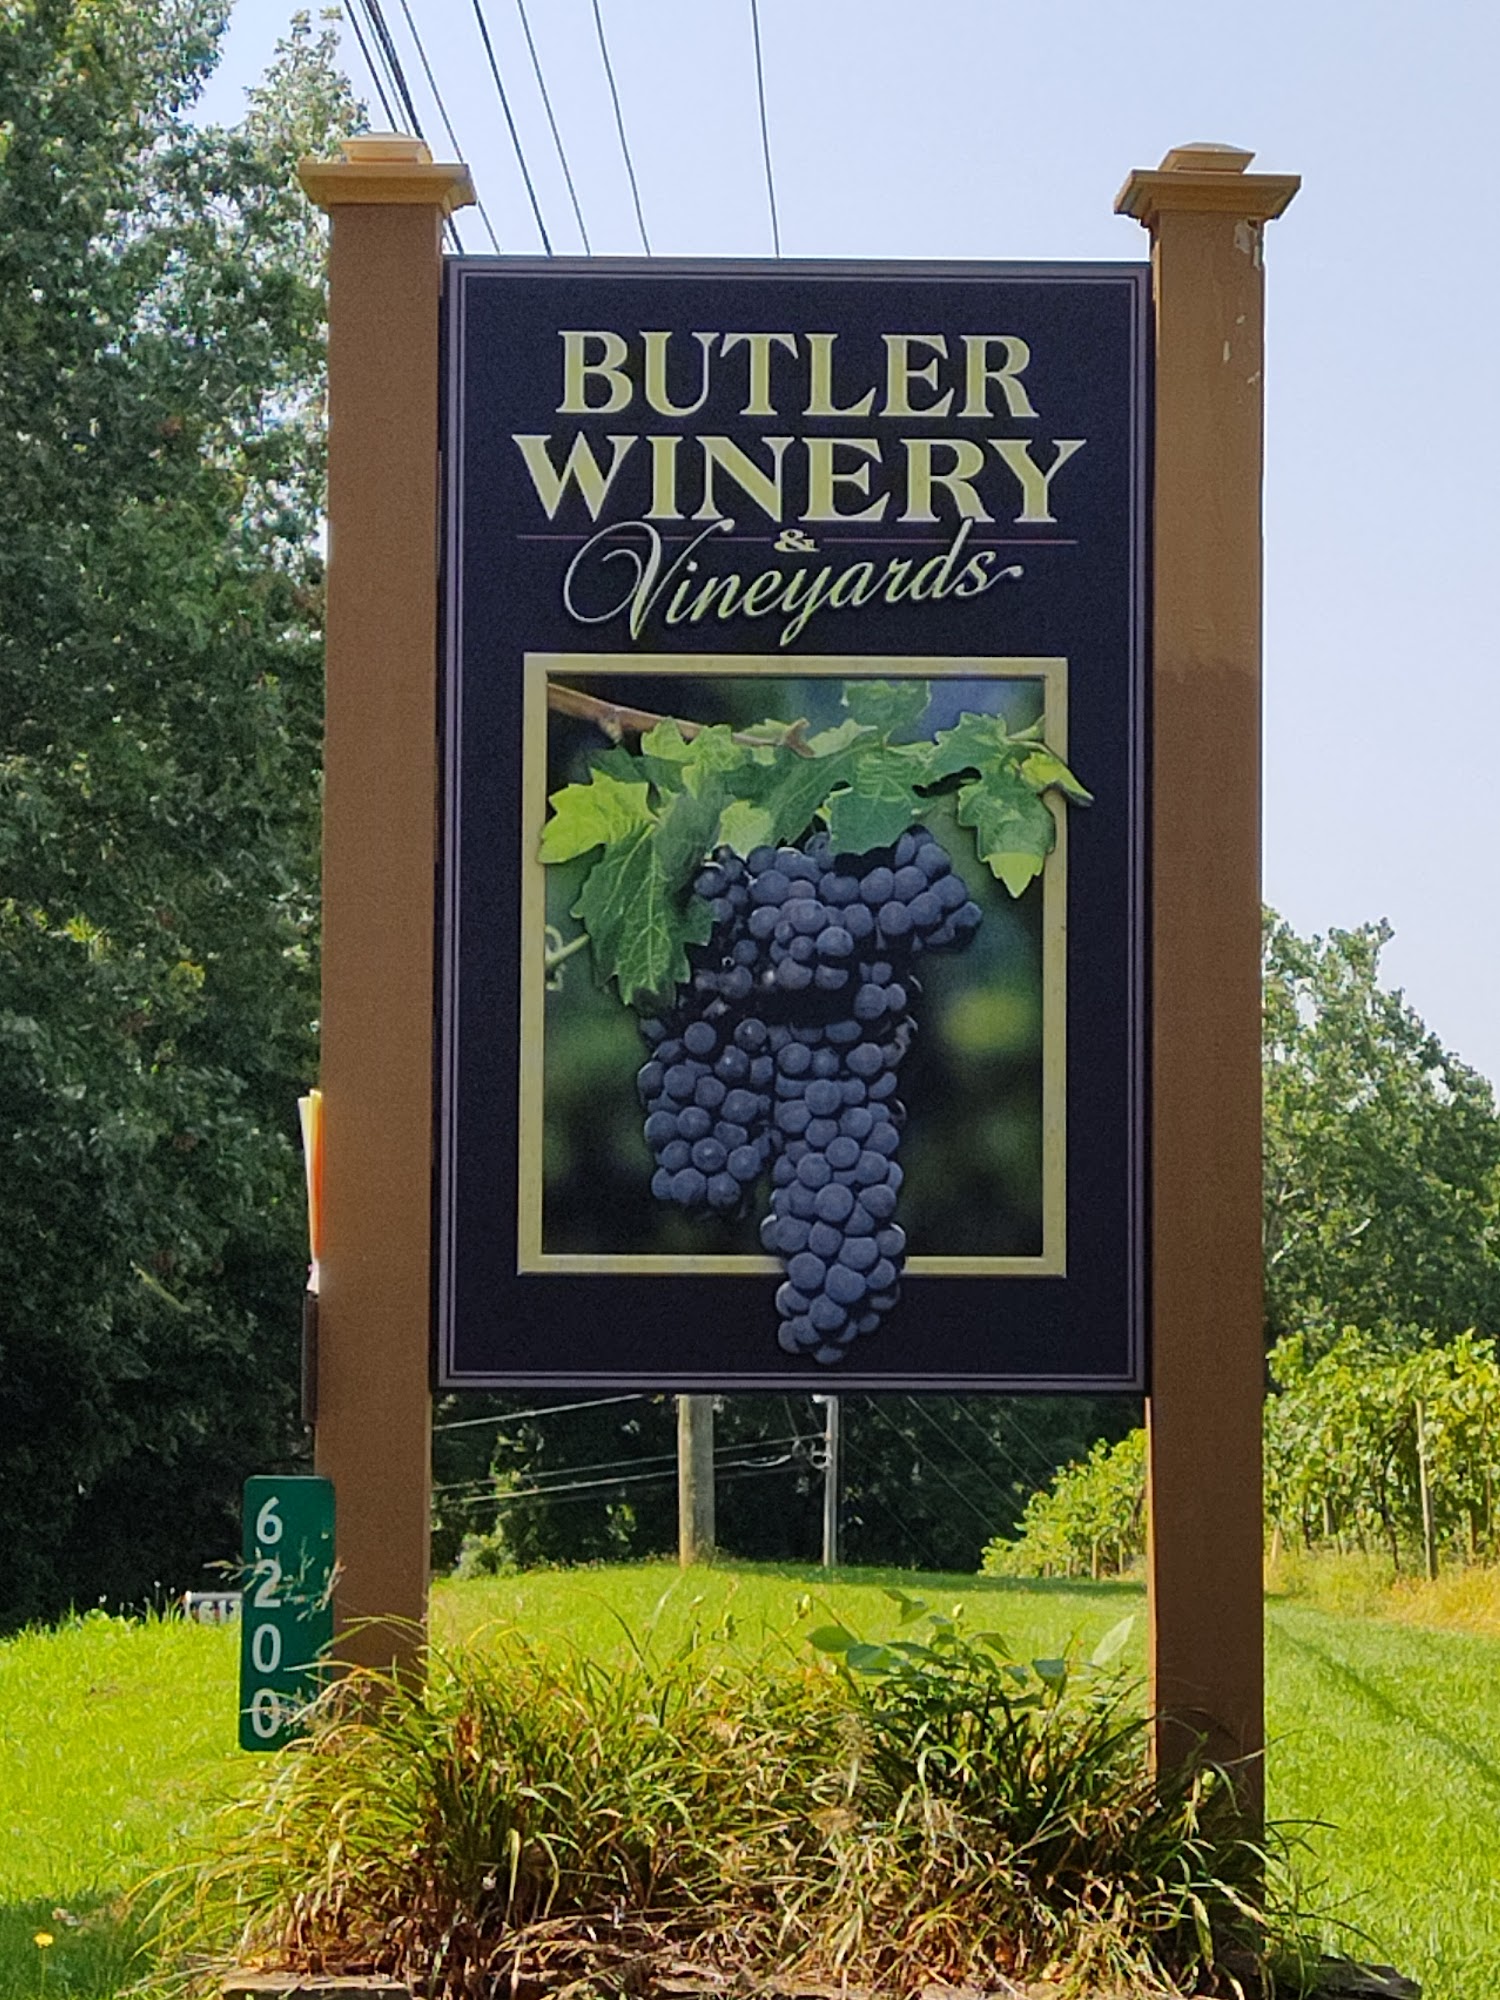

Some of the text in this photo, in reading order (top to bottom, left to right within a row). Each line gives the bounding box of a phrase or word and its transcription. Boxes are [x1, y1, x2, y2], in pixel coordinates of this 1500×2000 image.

[556, 330, 1039, 418] BUTLER
[511, 431, 1087, 523] WINERY
[564, 518, 1022, 646] Vineyards
[773, 528, 818, 553] &
[251, 1496, 283, 1739] 6200
